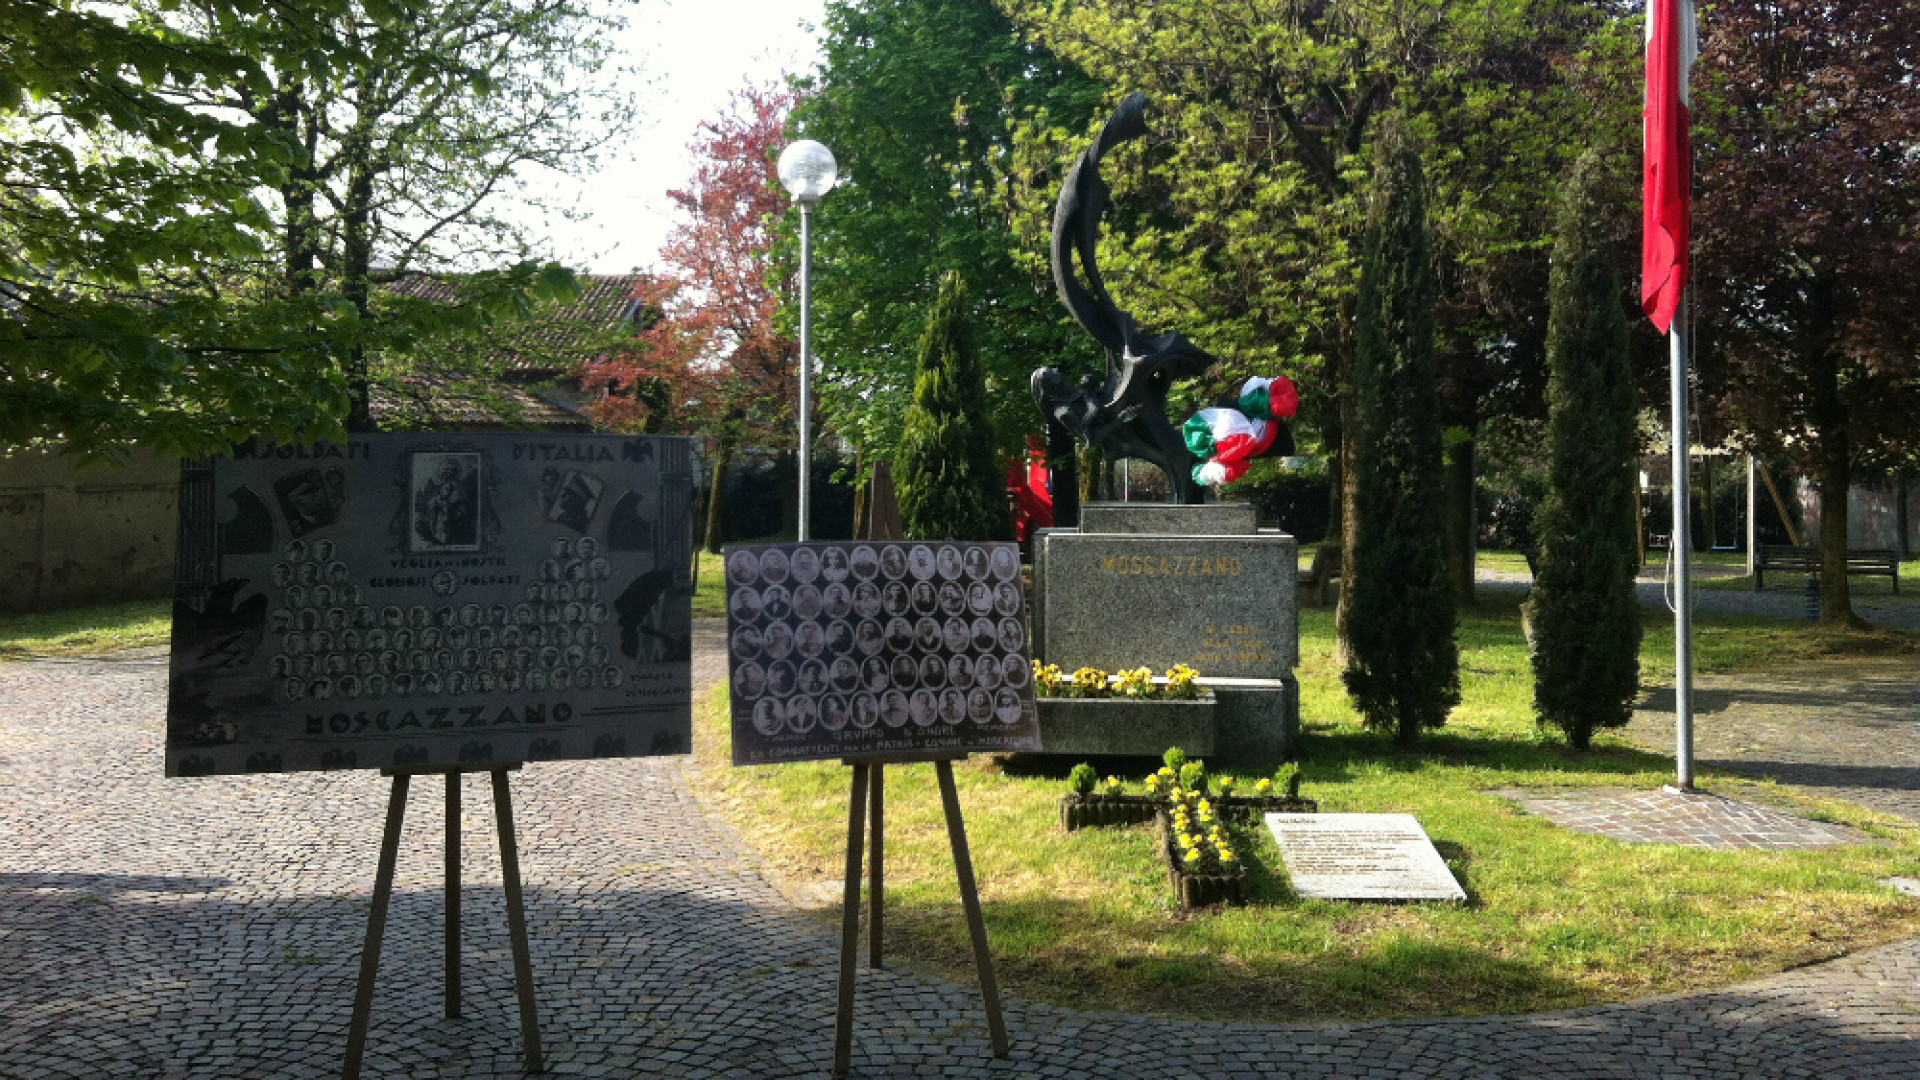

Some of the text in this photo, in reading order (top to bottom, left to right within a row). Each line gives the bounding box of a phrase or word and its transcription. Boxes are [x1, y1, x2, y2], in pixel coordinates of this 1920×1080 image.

[258, 441, 614, 462] SOLDATI D'ITALIA
[1103, 555, 1240, 576] MOSCAZZANO
[306, 702, 574, 735] MOSCAZZANO
